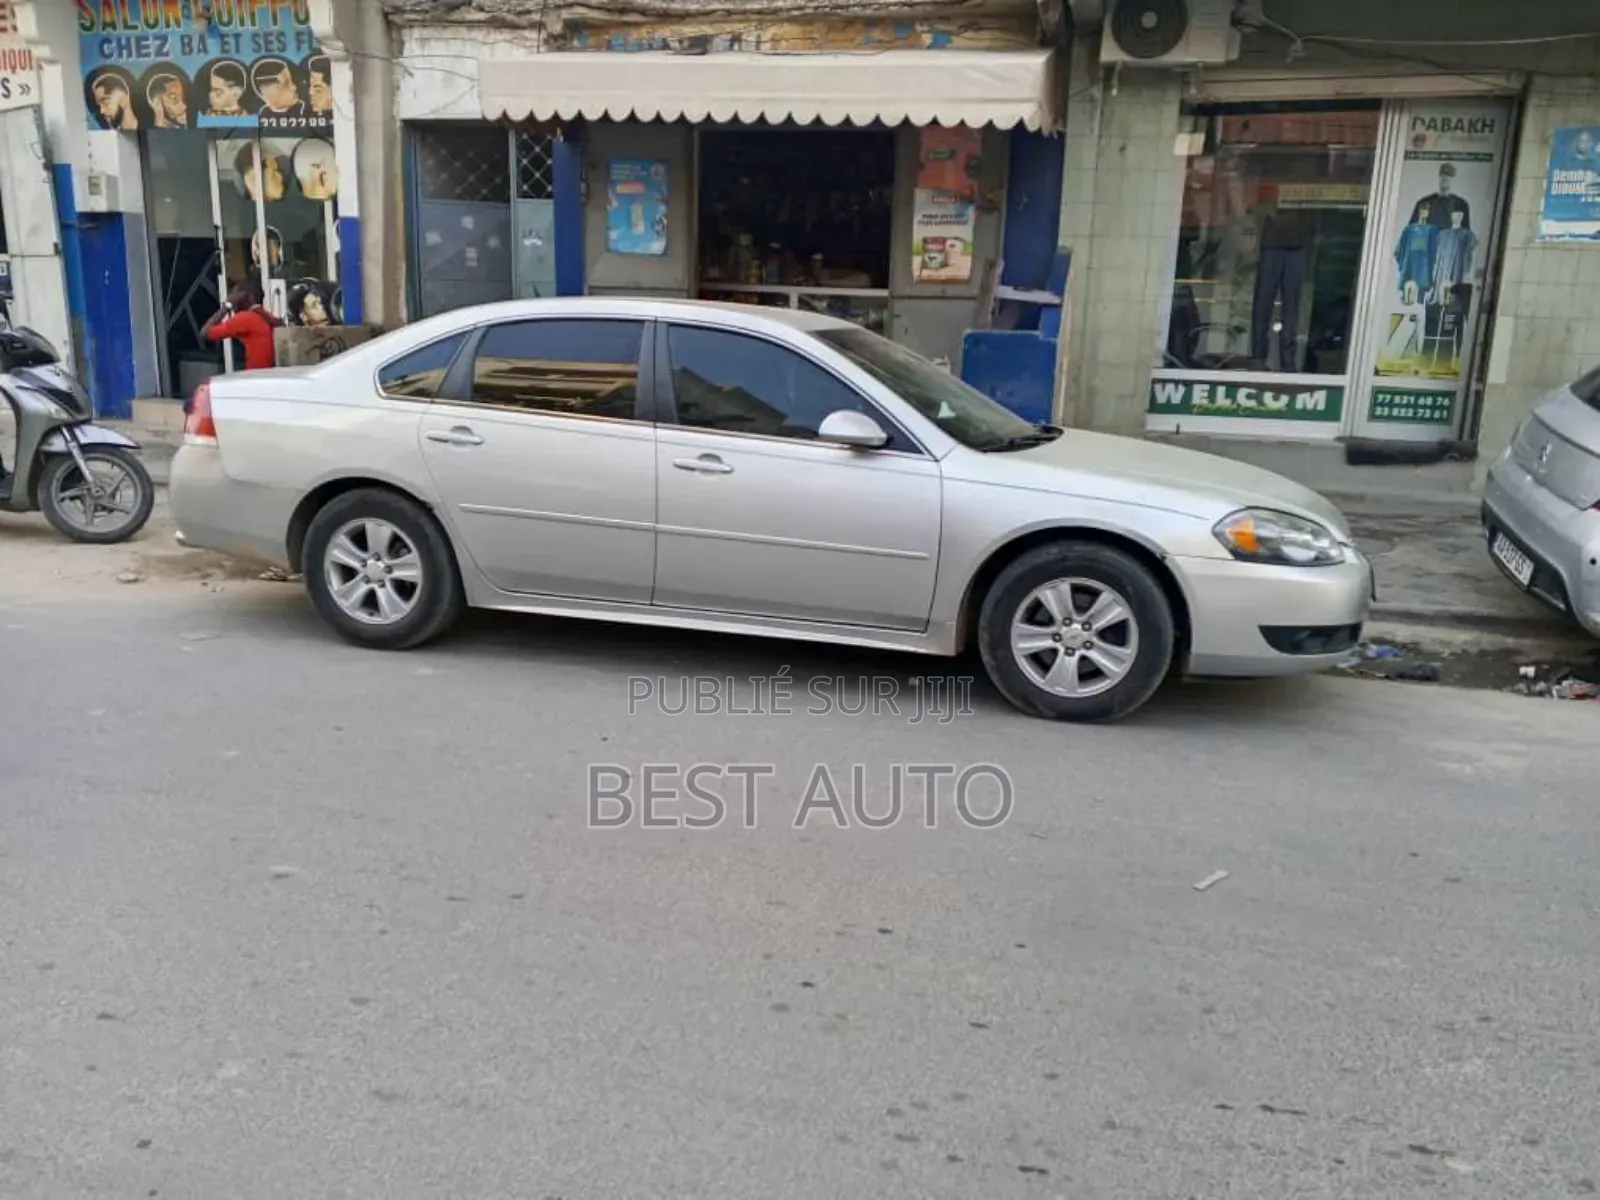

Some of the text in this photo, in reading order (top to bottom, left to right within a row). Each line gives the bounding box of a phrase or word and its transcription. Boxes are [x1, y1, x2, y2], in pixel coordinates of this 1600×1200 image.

[99, 36, 170, 59] CHEZ
[180, 34, 209, 56] BA
[220, 32, 242, 54] ET
[251, 31, 287, 53] SES
[1153, 382, 1328, 411] WELCOM
